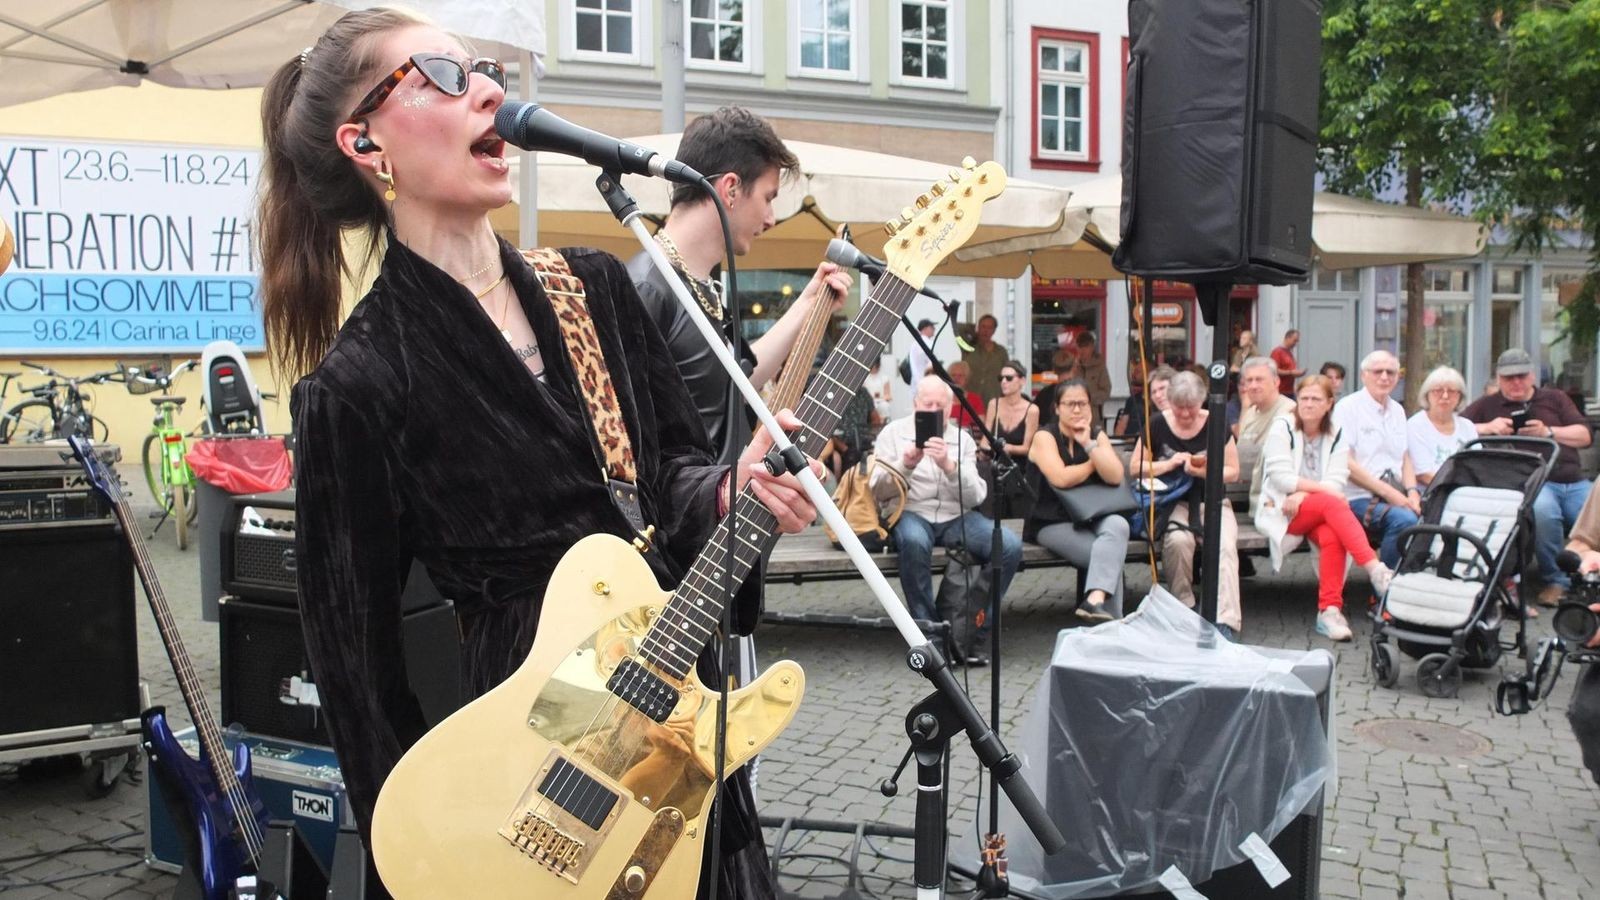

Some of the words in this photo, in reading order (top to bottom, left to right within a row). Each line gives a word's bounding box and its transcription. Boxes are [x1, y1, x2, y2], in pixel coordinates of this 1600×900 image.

[13, 211, 194, 272] ERATION
[210, 216, 254, 272] #1
[0, 277, 254, 312] CHSOMMER
[111, 319, 189, 341] Carina
[196, 320, 256, 344] Linge
[294, 794, 329, 816] THON
